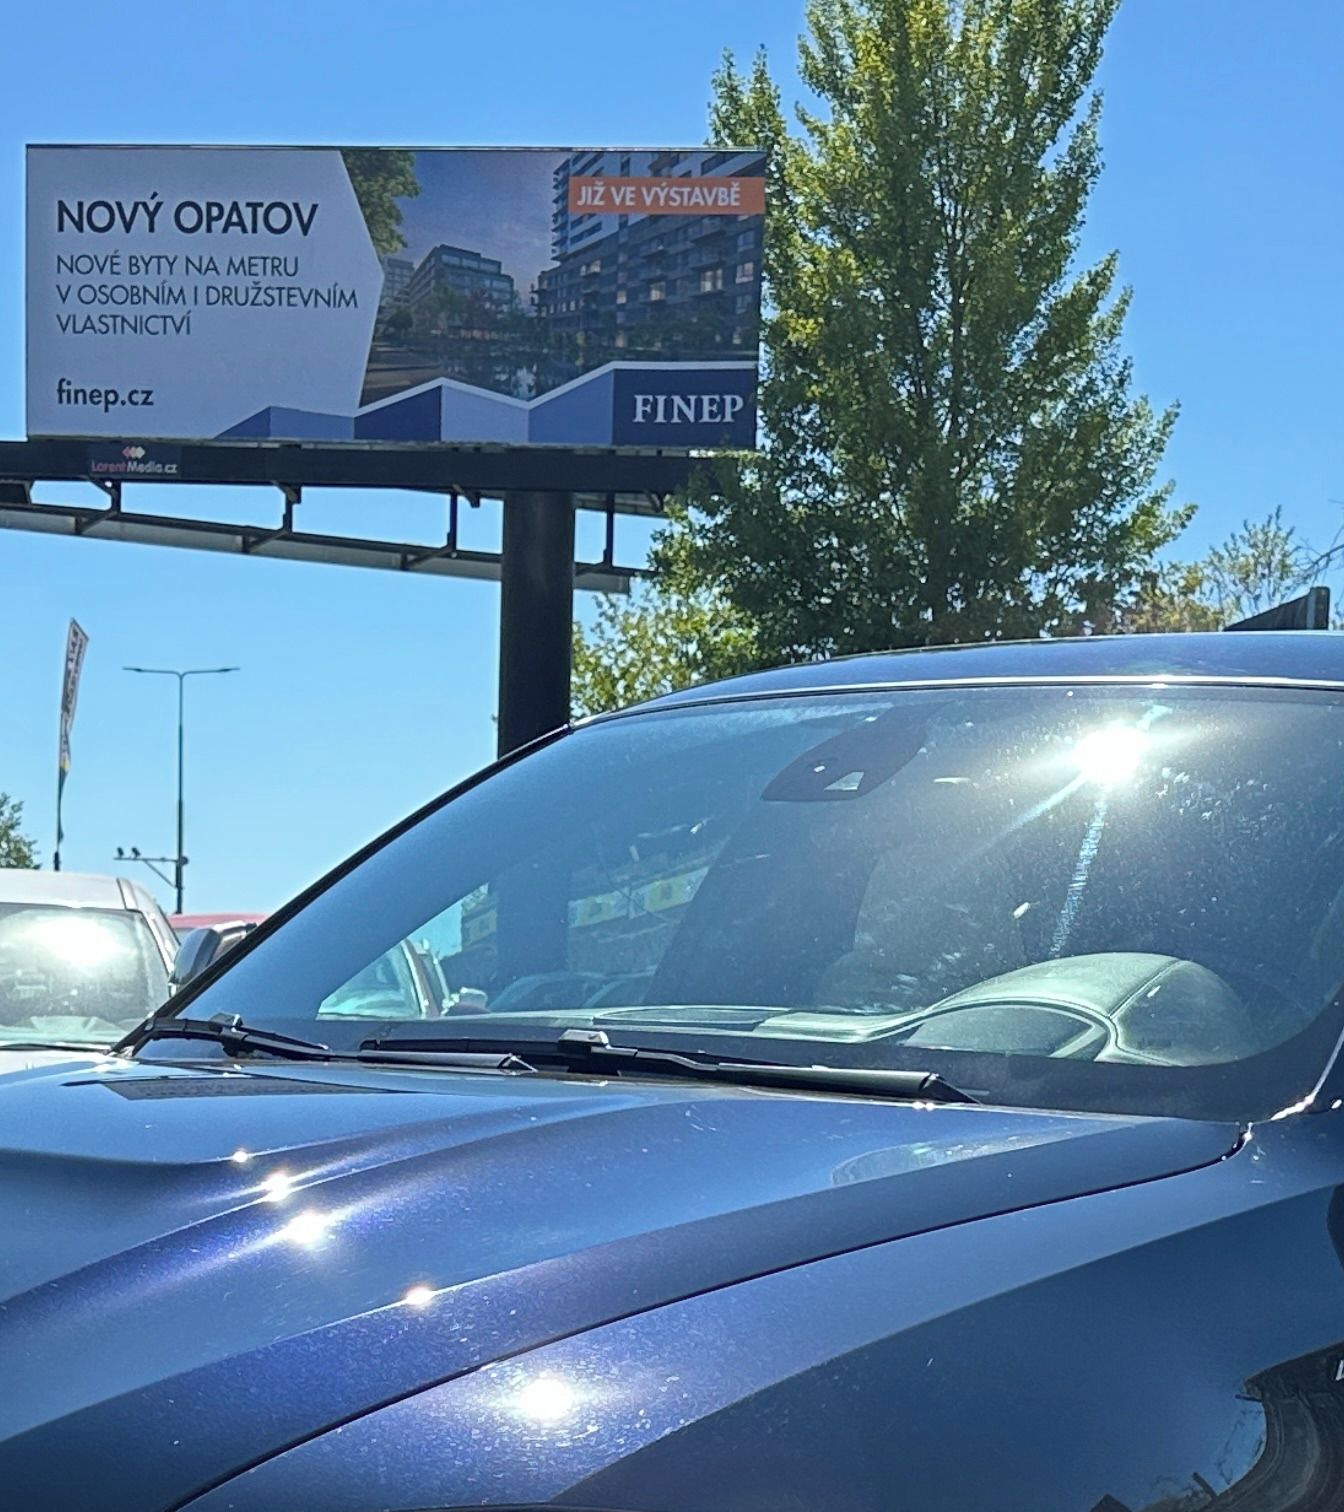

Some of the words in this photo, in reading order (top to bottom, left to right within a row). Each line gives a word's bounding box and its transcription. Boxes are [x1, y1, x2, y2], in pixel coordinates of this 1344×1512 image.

[577, 181, 605, 206] JIŽ
[610, 186, 636, 206] VE
[641, 182, 741, 207] VÝSTAVBĚ
[57, 191, 164, 234] NOVÝ
[173, 200, 319, 237] OPATOV
[56, 250, 121, 275] NOVÉ
[129, 255, 178, 275] BYTY
[185, 256, 221, 276] NA
[226, 256, 299, 277] METRU
[56, 285, 71, 304] V
[77, 280, 186, 305] OSOBNÍM
[194, 286, 198, 306] I
[206, 281, 358, 309] DRUŽSTEVNÍM
[56, 310, 191, 335] VLASTNICTVÍ
[57, 378, 154, 413] finep.cz
[632, 394, 744, 424] FINEP
